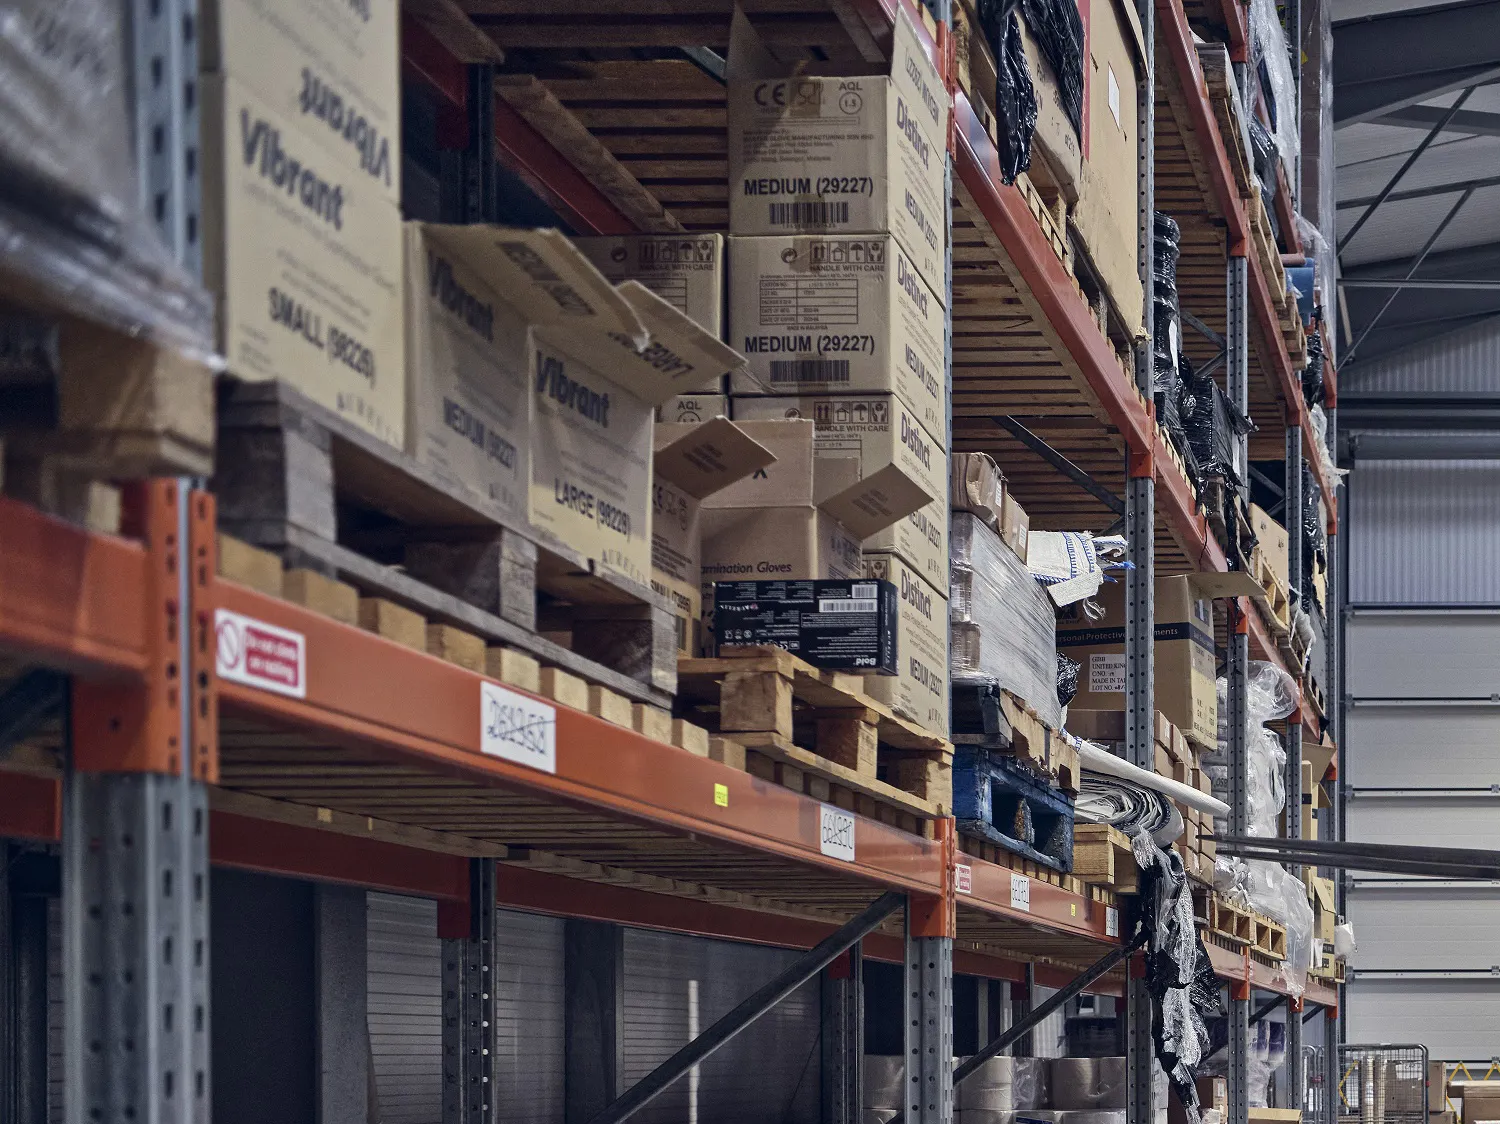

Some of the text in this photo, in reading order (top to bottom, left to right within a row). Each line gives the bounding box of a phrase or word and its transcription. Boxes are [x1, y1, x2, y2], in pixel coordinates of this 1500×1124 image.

[839, 81, 863, 91] AQL
[896, 97, 929, 171] Distinct
[240, 107, 345, 231] Vibrant
[744, 177, 874, 197] MEDIUM (29227)
[863, 264, 885, 272] CARE
[897, 252, 929, 320] Distinct
[268, 287, 325, 350] SMALL
[745, 335, 875, 355] MEDIUM (29227)
[537, 350, 610, 428] Vibrant
[677, 401, 702, 410] AQL
[867, 424, 889, 432] CARE
[900, 411, 931, 472] Distinct
[555, 477, 594, 520] LARGE
[756, 561, 792, 574] Gloves
[900, 567, 932, 622] Distinct
[1057, 633, 1086, 643] ersonal
